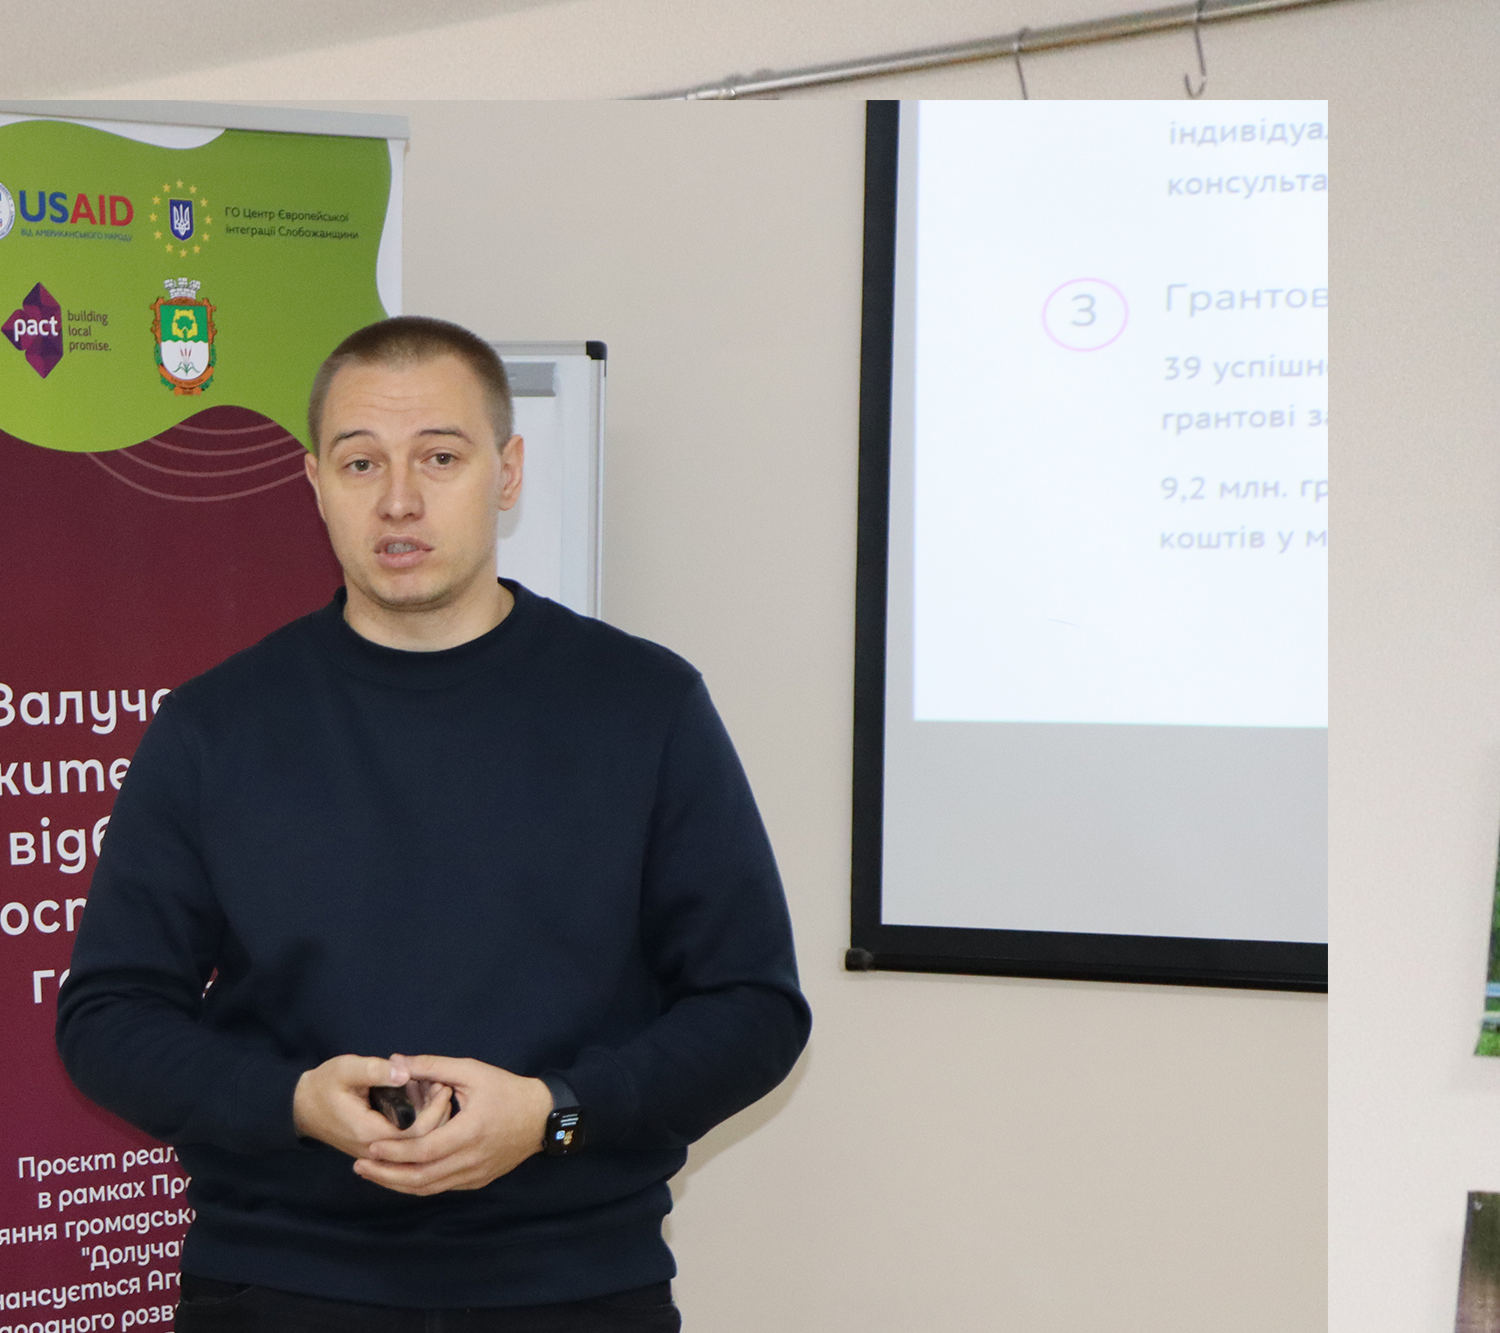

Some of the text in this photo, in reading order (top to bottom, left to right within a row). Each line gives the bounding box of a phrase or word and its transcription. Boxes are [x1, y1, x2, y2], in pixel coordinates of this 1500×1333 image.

[1169, 117, 1328, 148] індивідуа
[19, 190, 134, 226] USAID
[225, 207, 349, 222] ГО Центр Європейської
[226, 224, 359, 240] інтеграції Слобожанщини
[67, 309, 108, 326] building
[1070, 294, 1097, 327] 3
[14, 316, 58, 341] pact
[68, 325, 91, 336] local
[69, 340, 111, 352] promise.
[1163, 354, 1328, 385] 39 успішн
[1161, 404, 1296, 435] грантові
[1160, 477, 1206, 504] 9,2
[1218, 477, 1289, 500] млн.
[1160, 525, 1266, 550] коштів
[18, 1151, 116, 1183] Проєкт
[38, 1190, 52, 1209] в
[58, 1180, 145, 1212] рамках
